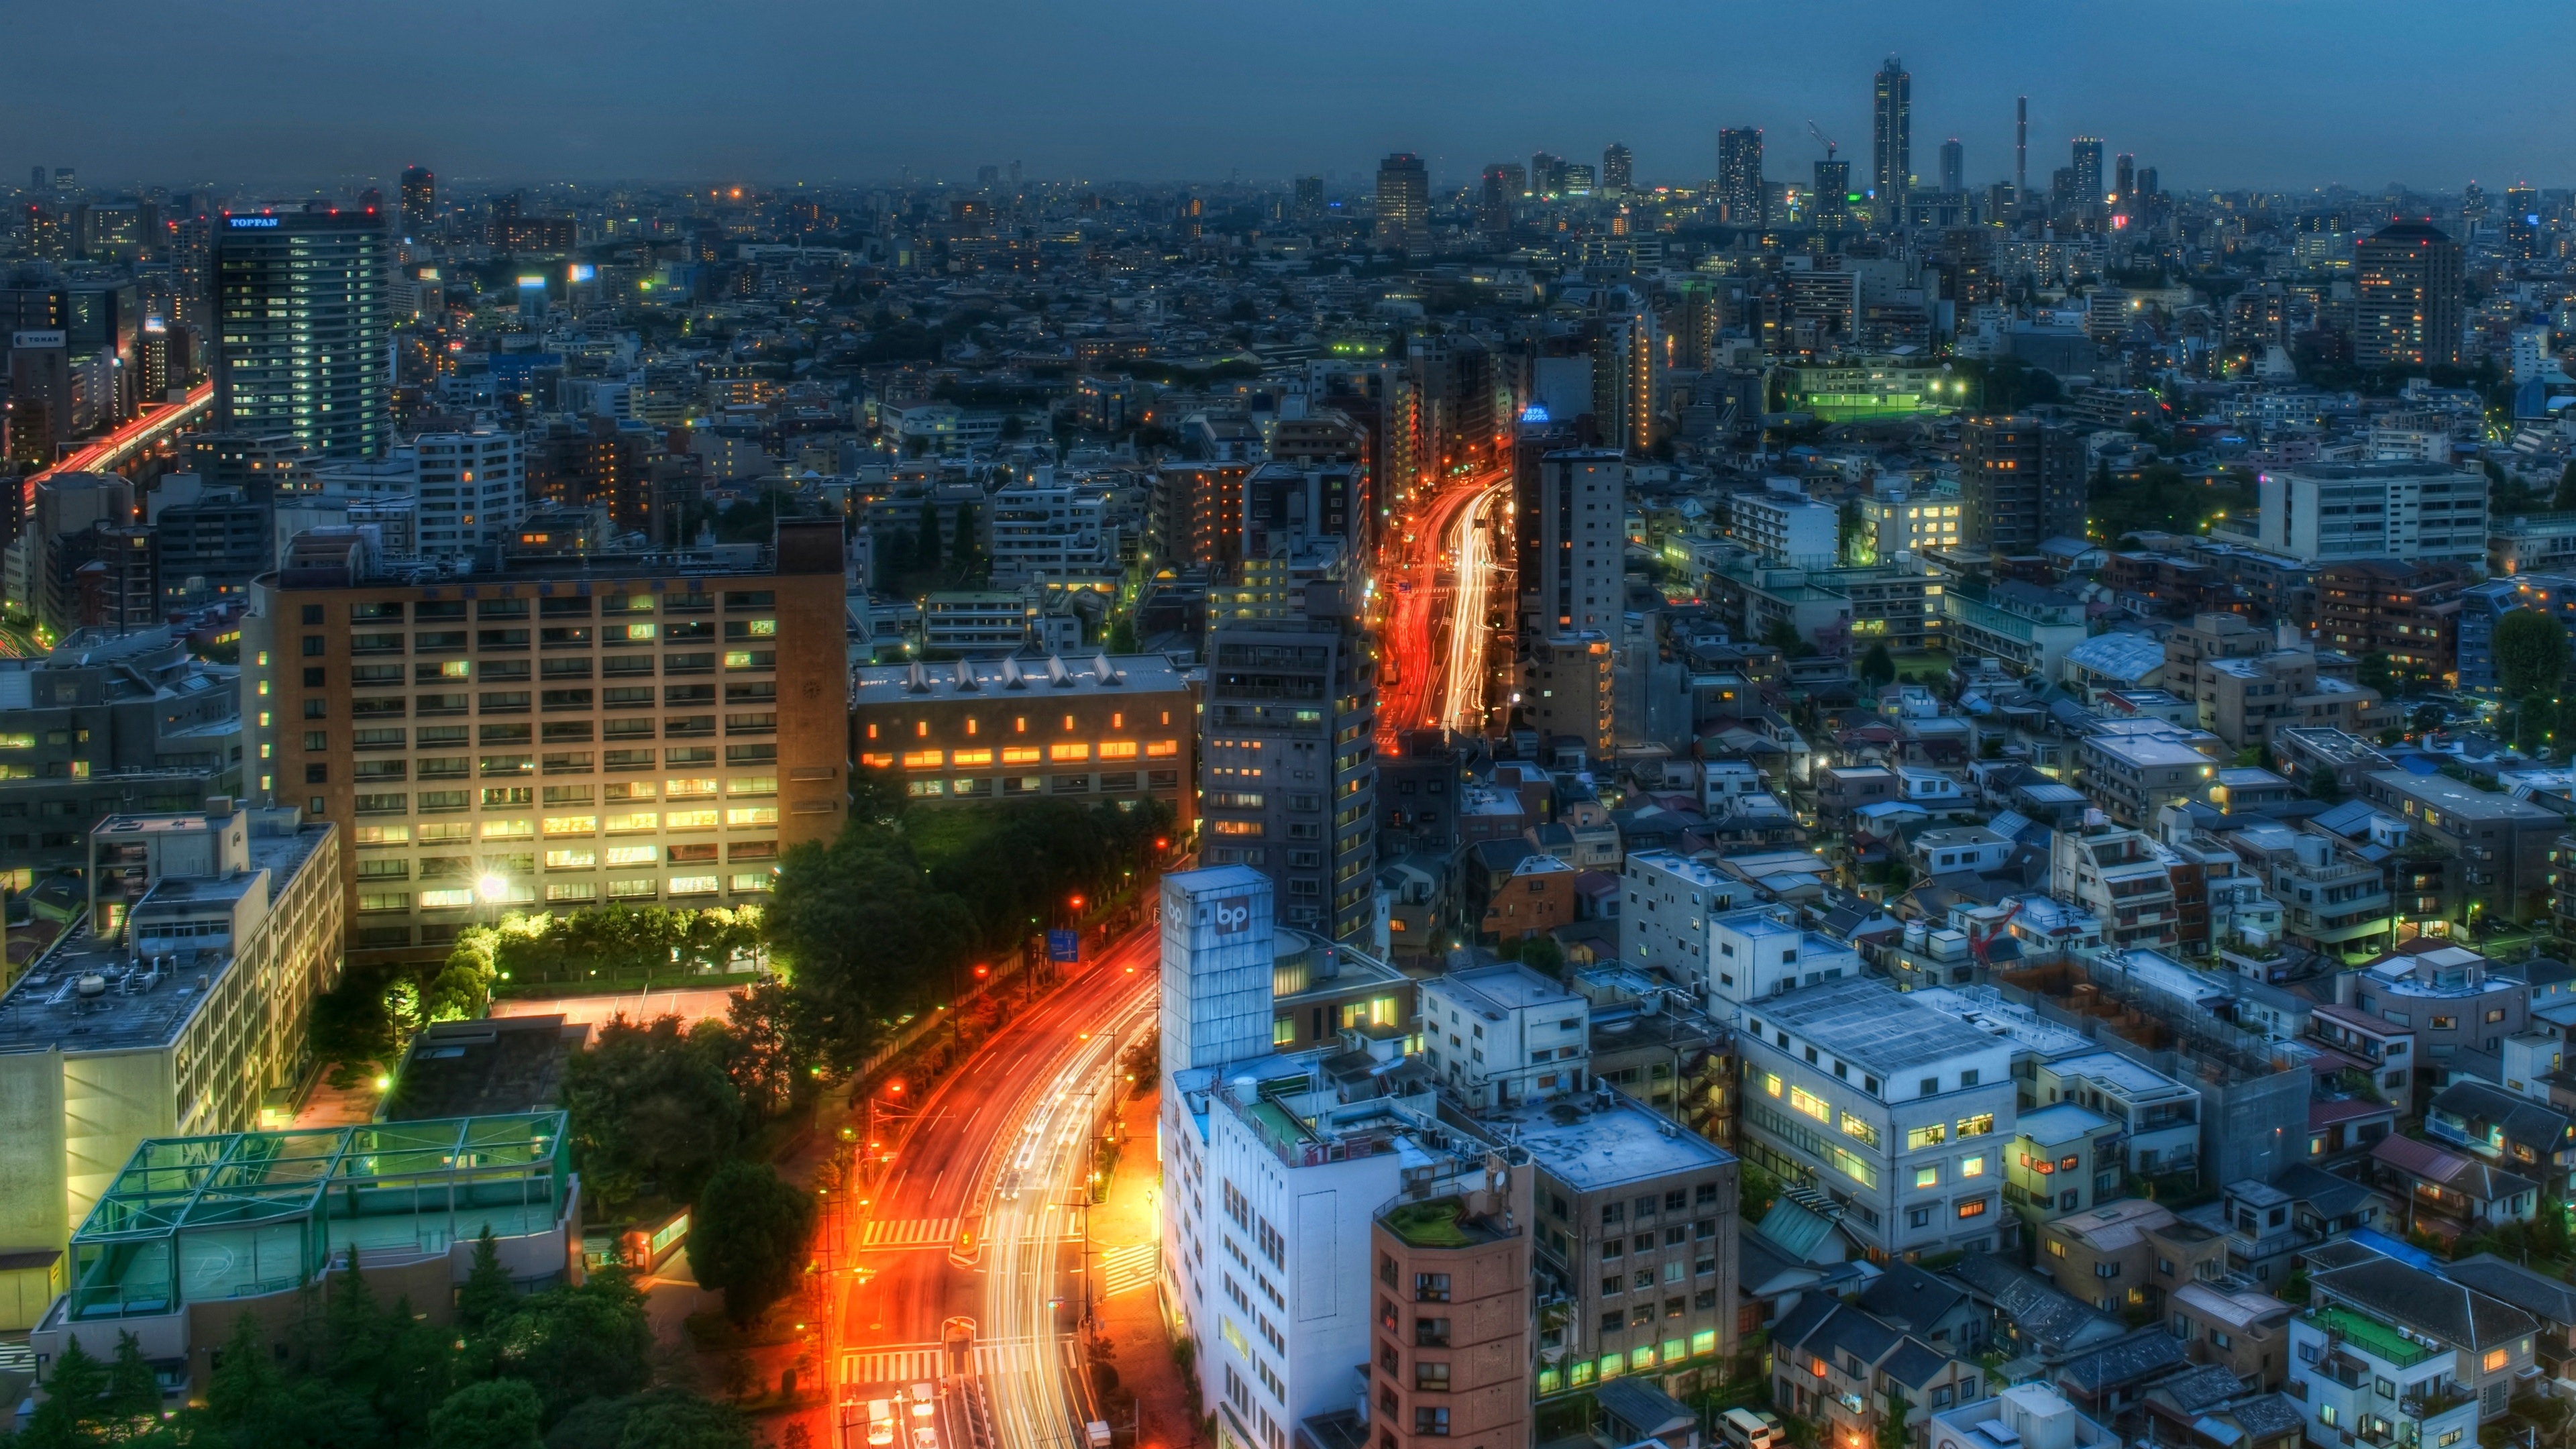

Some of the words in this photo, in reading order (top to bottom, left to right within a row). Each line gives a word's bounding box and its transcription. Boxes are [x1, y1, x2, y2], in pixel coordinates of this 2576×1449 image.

[230, 219, 278, 227] TOPPAN
[1168, 894, 1182, 930] bp
[1217, 902, 1247, 931] bp
